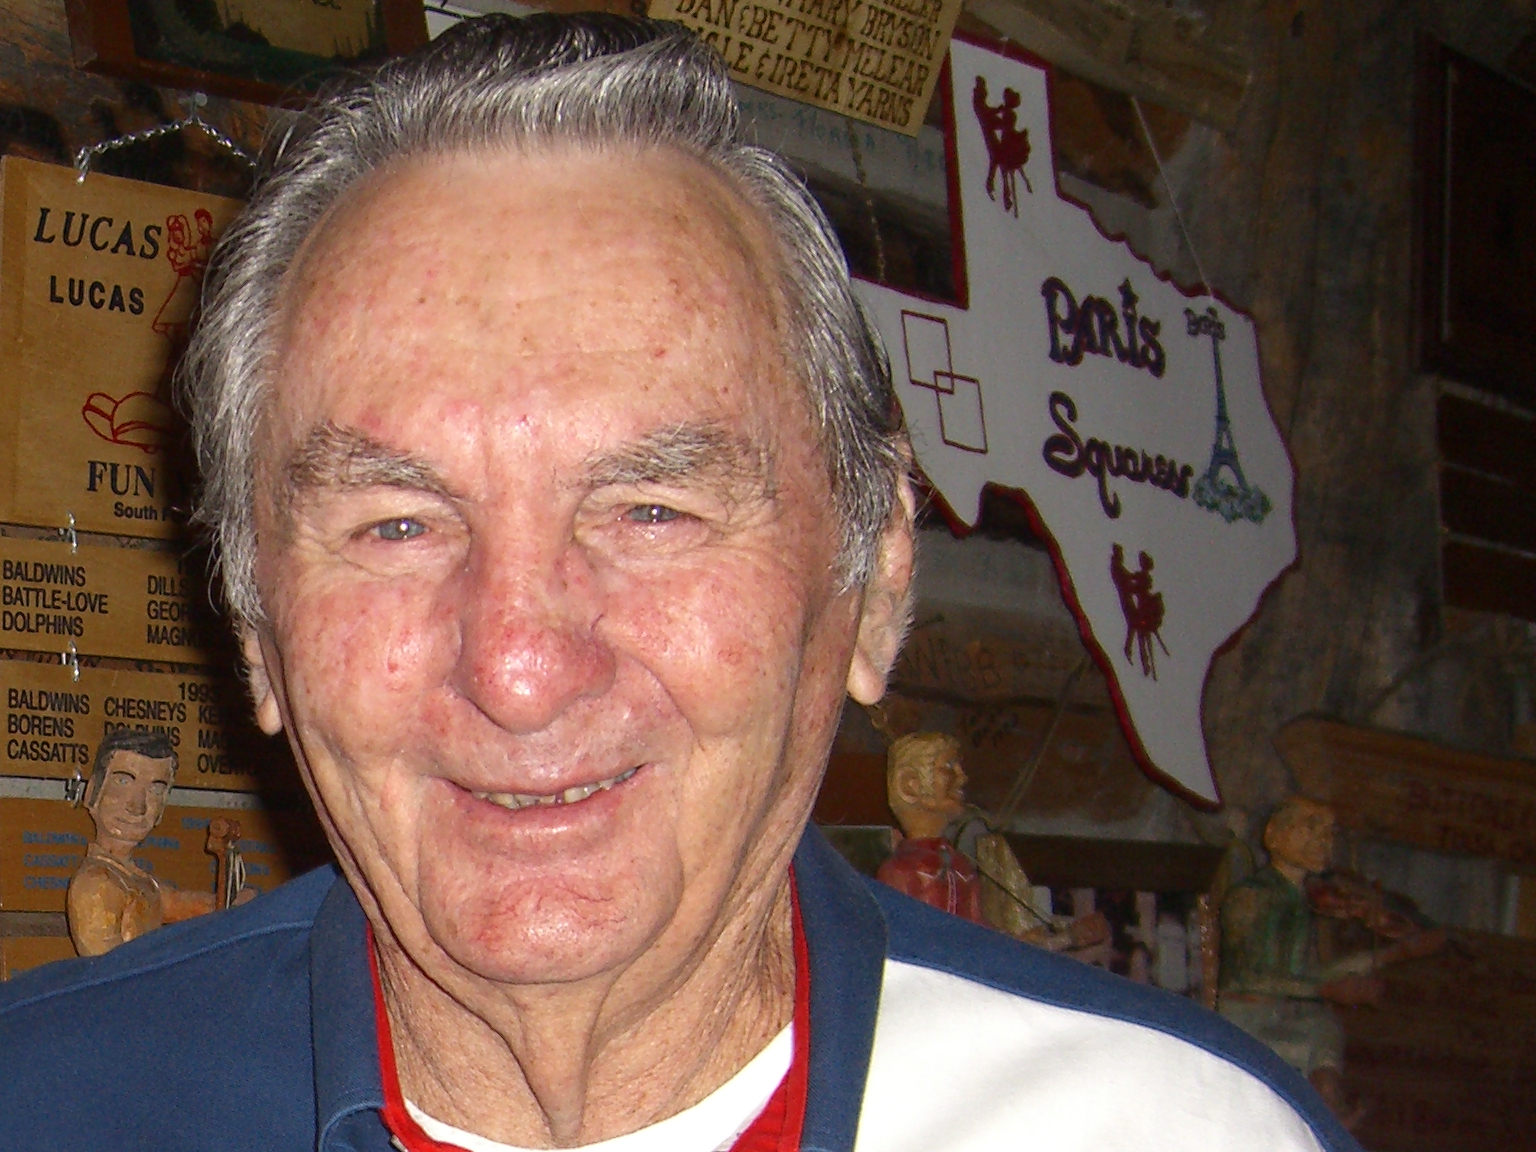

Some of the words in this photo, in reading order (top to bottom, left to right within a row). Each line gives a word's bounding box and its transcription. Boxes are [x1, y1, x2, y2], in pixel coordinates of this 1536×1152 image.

[33, 206, 162, 260] LUCAS
[48, 275, 145, 316] LUCAS
[86, 460, 156, 498] FUN
[113, 501, 158, 521] South
[2, 560, 86, 587] BALDWINS
[2, 585, 109, 614] BATTLE-LOVE
[1, 610, 84, 638] DOLPHINS
[7, 688, 90, 716] BALDWINS
[103, 696, 187, 724] CHESNEYS
[7, 714, 75, 739] BORENS
[6, 738, 90, 765] CASSATTS
